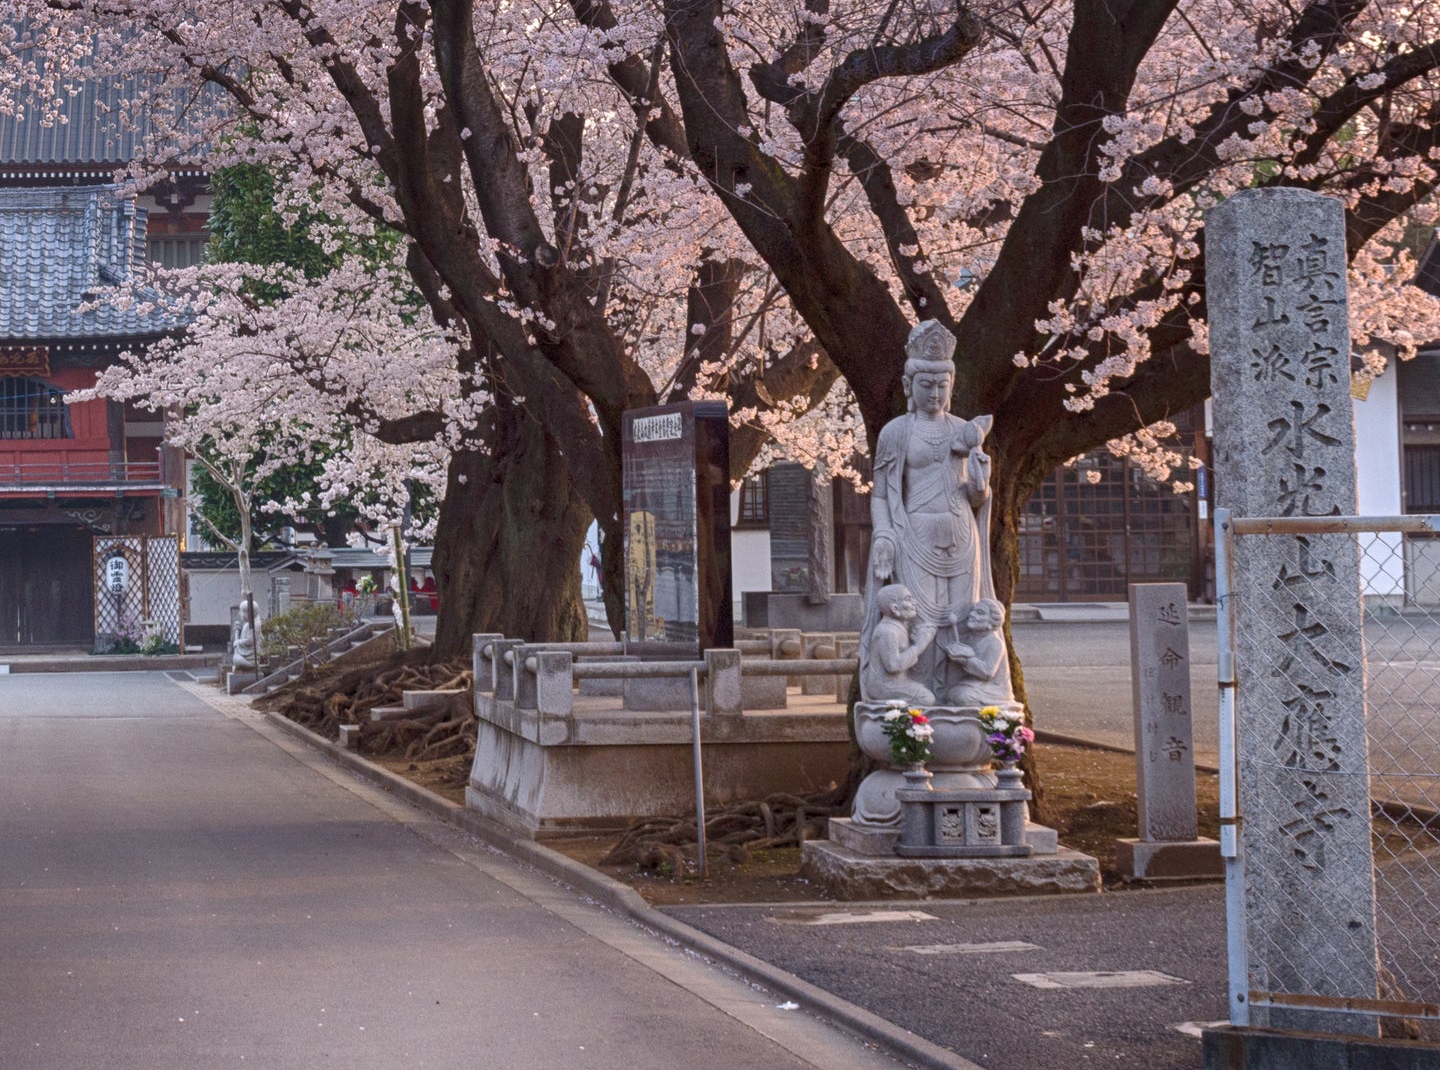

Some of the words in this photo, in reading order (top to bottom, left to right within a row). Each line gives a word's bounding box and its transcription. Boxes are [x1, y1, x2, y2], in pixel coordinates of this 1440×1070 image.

[1250, 240, 1296, 382] 智山派
[1295, 233, 1340, 390] 真言宗
[1158, 602, 1187, 763] 延命観音
